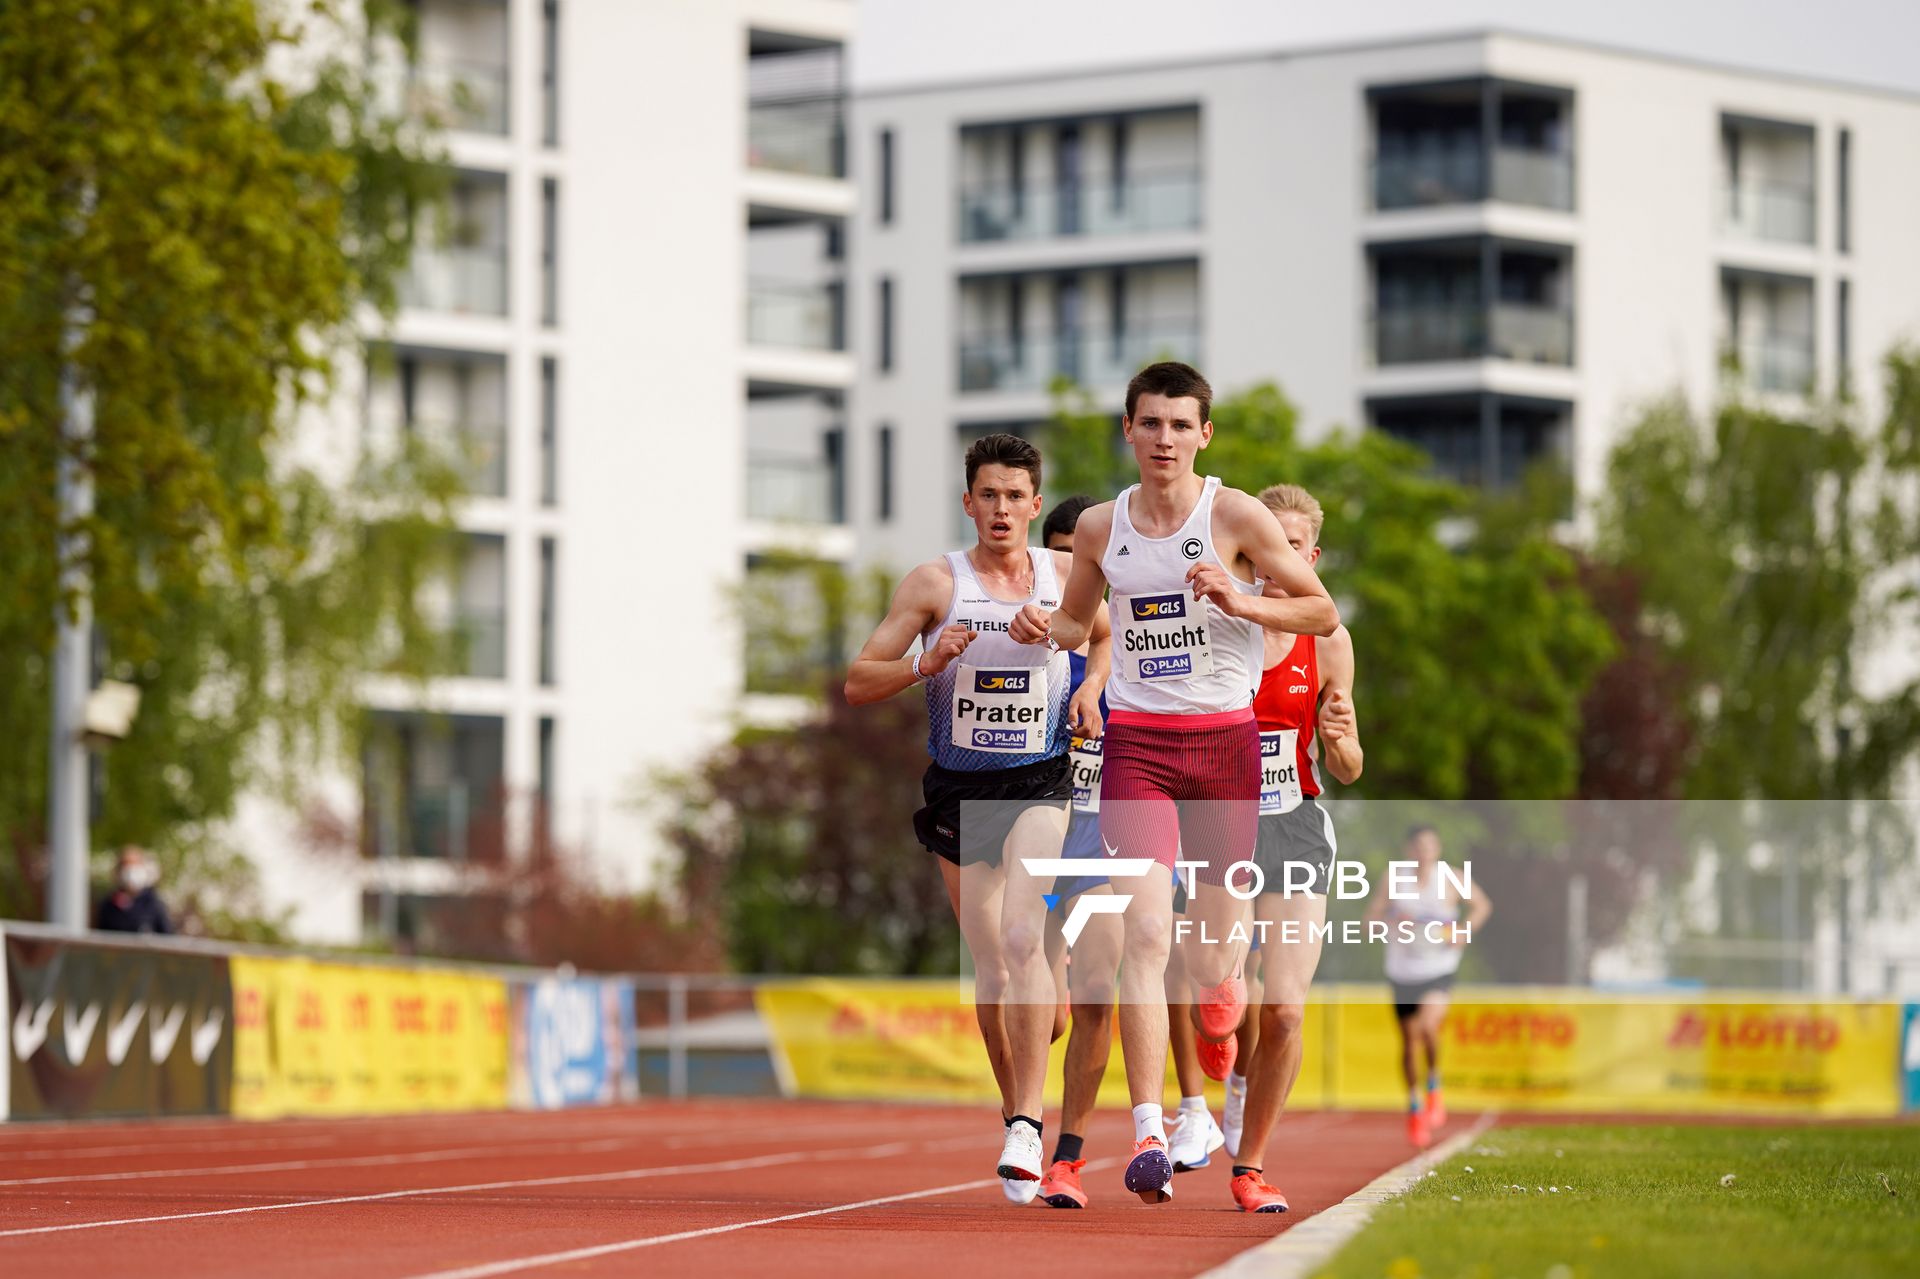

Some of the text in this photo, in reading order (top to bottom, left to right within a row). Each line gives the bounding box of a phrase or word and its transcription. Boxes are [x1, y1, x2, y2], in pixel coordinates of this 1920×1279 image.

[1158, 601, 1180, 615] GLS
[974, 620, 1009, 632] TELIS
[1125, 625, 1206, 652] Schucht
[1158, 658, 1189, 670] PLAN
[1004, 677, 1026, 689] GLS
[957, 698, 1044, 723] Prater
[994, 733, 1025, 742] PLAN
[1082, 739, 1102, 752] GLS
[1259, 793, 1279, 805] LAN
